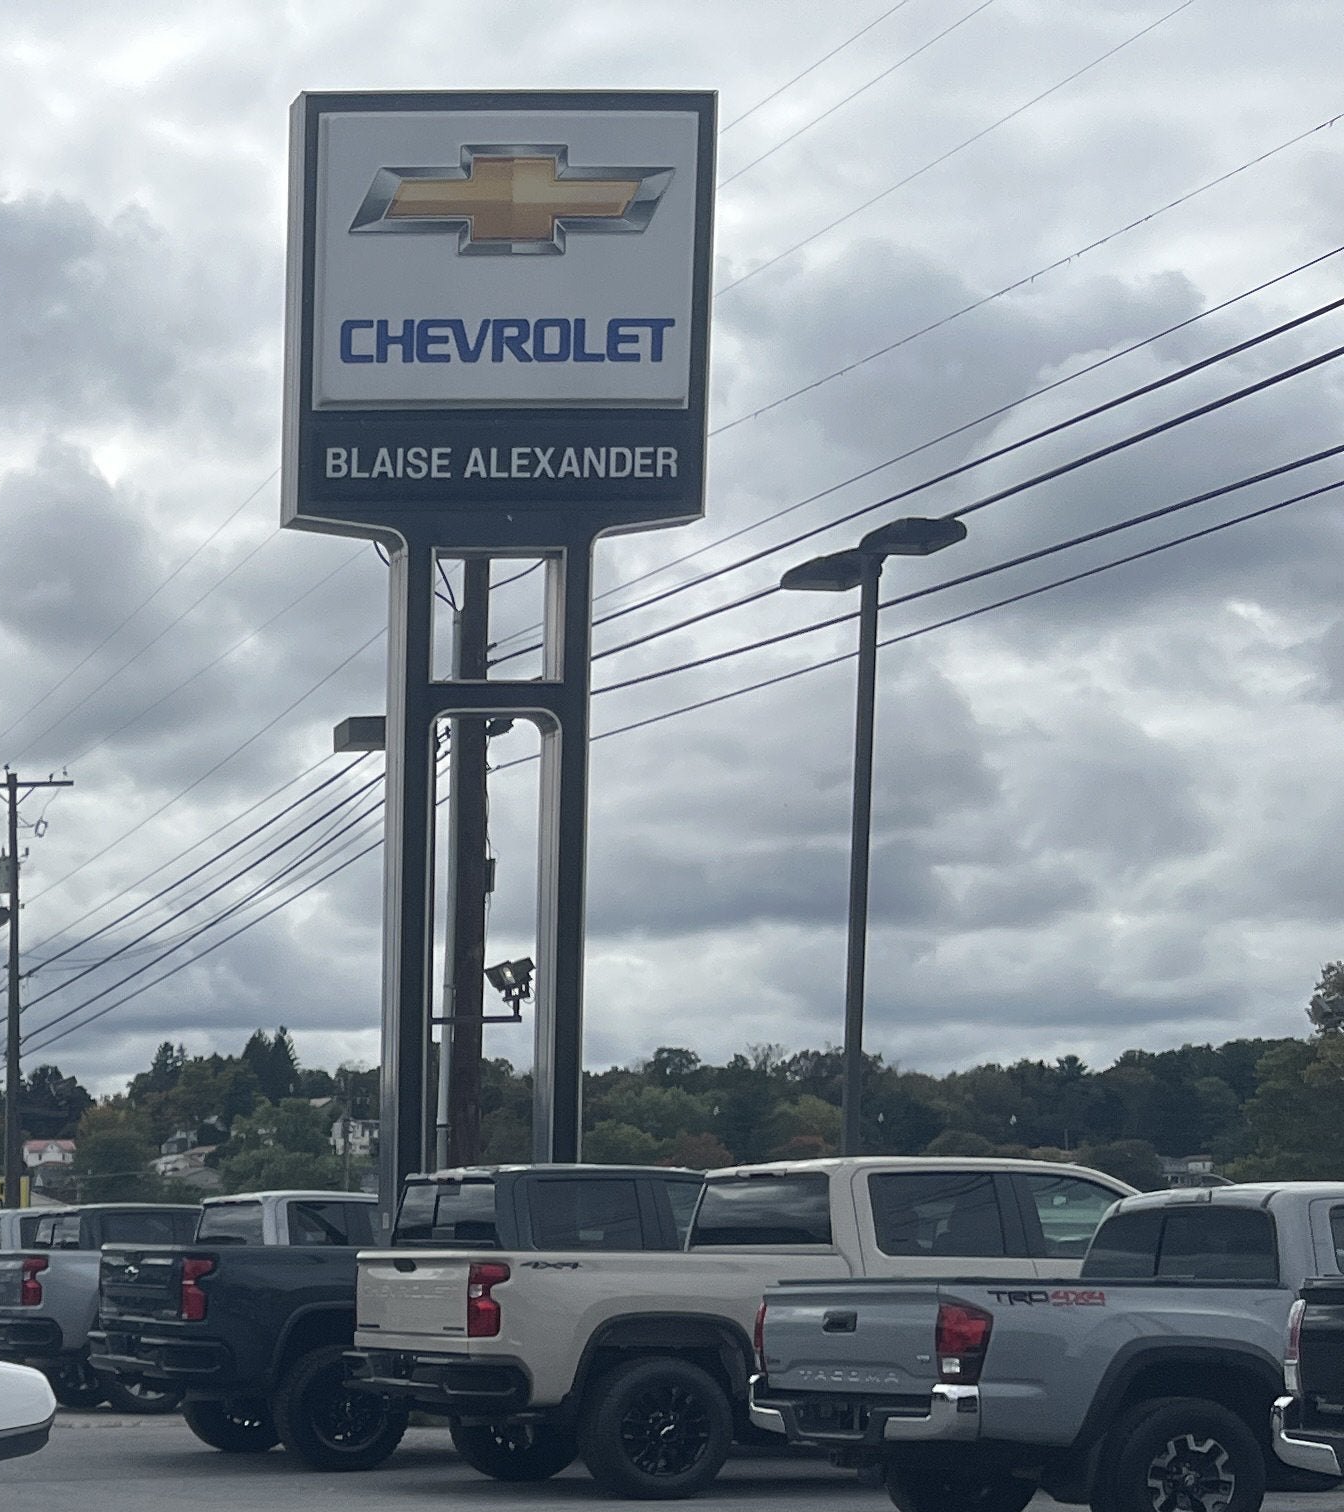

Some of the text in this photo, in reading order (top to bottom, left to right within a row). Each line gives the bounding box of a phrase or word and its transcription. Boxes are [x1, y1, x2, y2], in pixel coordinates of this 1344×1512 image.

[339, 317, 676, 364] CHEVROLET
[325, 446, 678, 480] BLAISE ALEXANDER
[987, 1290, 1049, 1305] TRD
